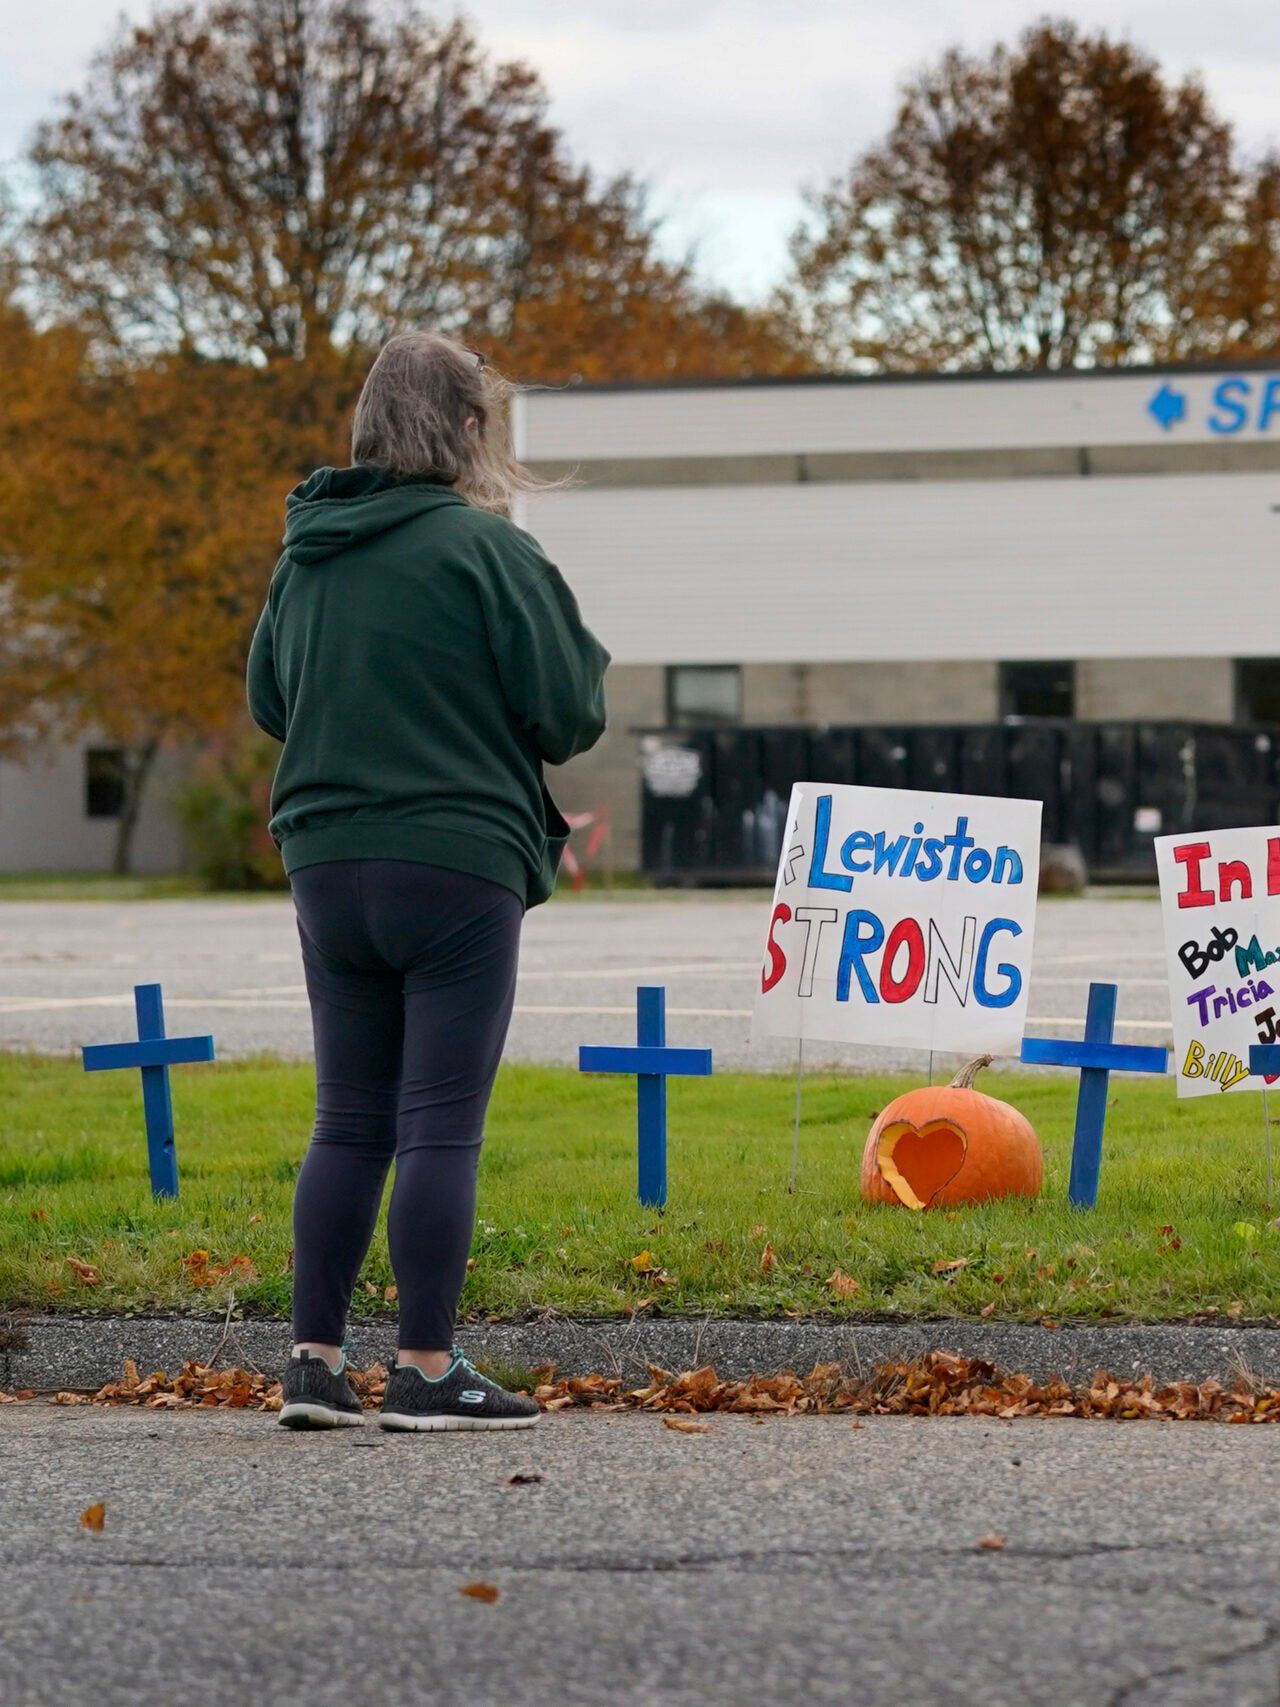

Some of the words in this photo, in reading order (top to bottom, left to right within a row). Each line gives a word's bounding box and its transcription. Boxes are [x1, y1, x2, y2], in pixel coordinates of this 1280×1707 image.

[807, 795, 1023, 893] Lewiston
[1173, 841, 1253, 909] In
[762, 903, 1023, 1008] STRONG
[1178, 926, 1239, 980] Bob
[1187, 979, 1275, 1027] Tricia
[1181, 1039, 1250, 1092] Billy
